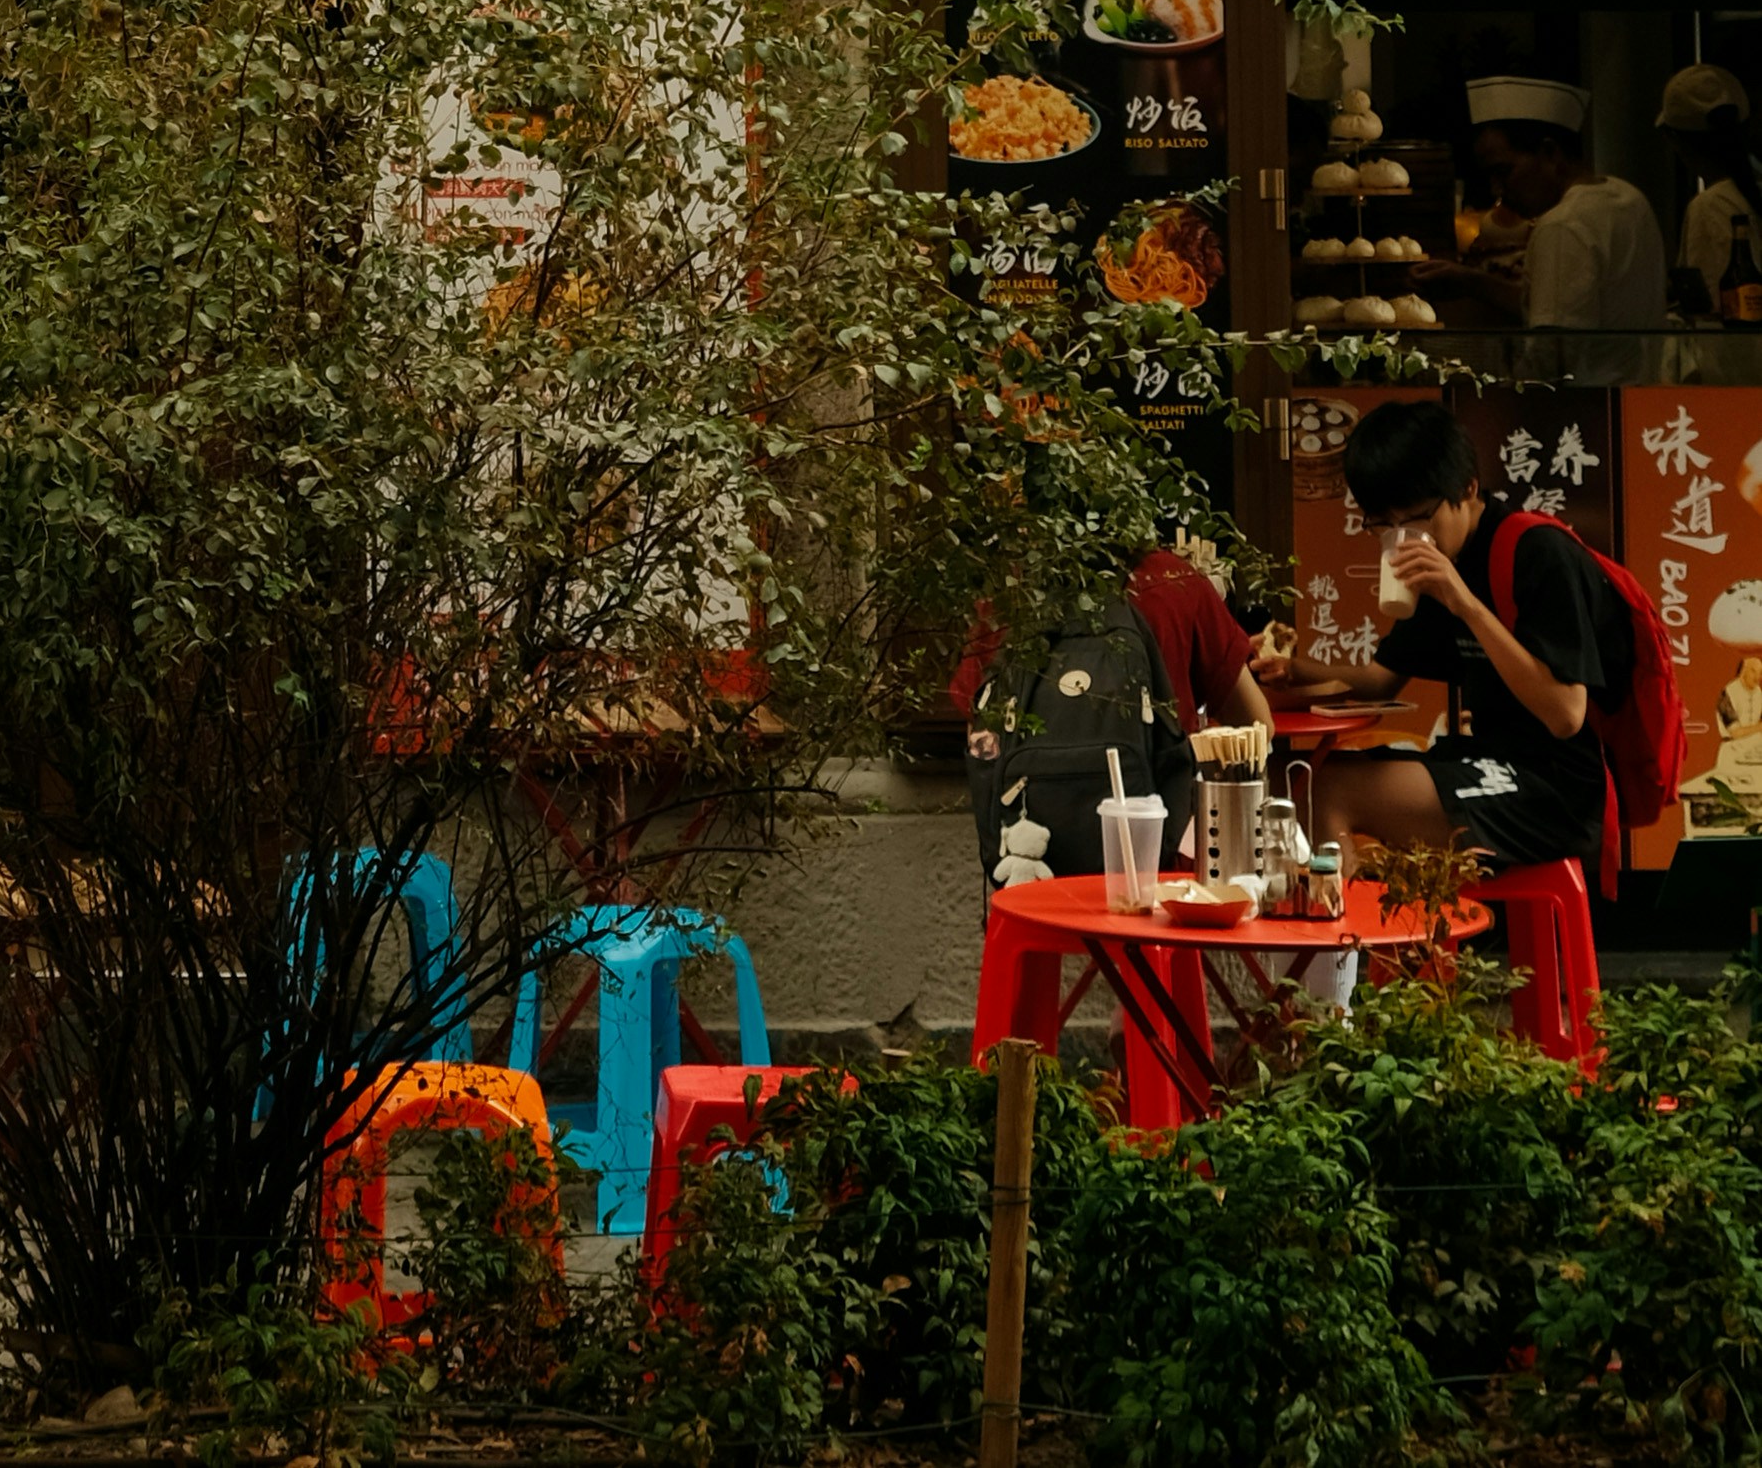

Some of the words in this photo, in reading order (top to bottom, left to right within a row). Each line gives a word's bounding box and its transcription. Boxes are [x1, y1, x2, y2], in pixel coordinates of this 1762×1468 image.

[1125, 95, 1208, 133] 炒饭
[1124, 138, 1154, 149] RISO
[1158, 138, 1209, 149] SALTATO
[984, 278, 1059, 290] AGLIATELLE
[1139, 405, 1204, 416] SPAGHETTI
[1139, 420, 1185, 430] SALTATI
[1641, 405, 1729, 554] 味道
[1660, 559, 1690, 627] BAO
